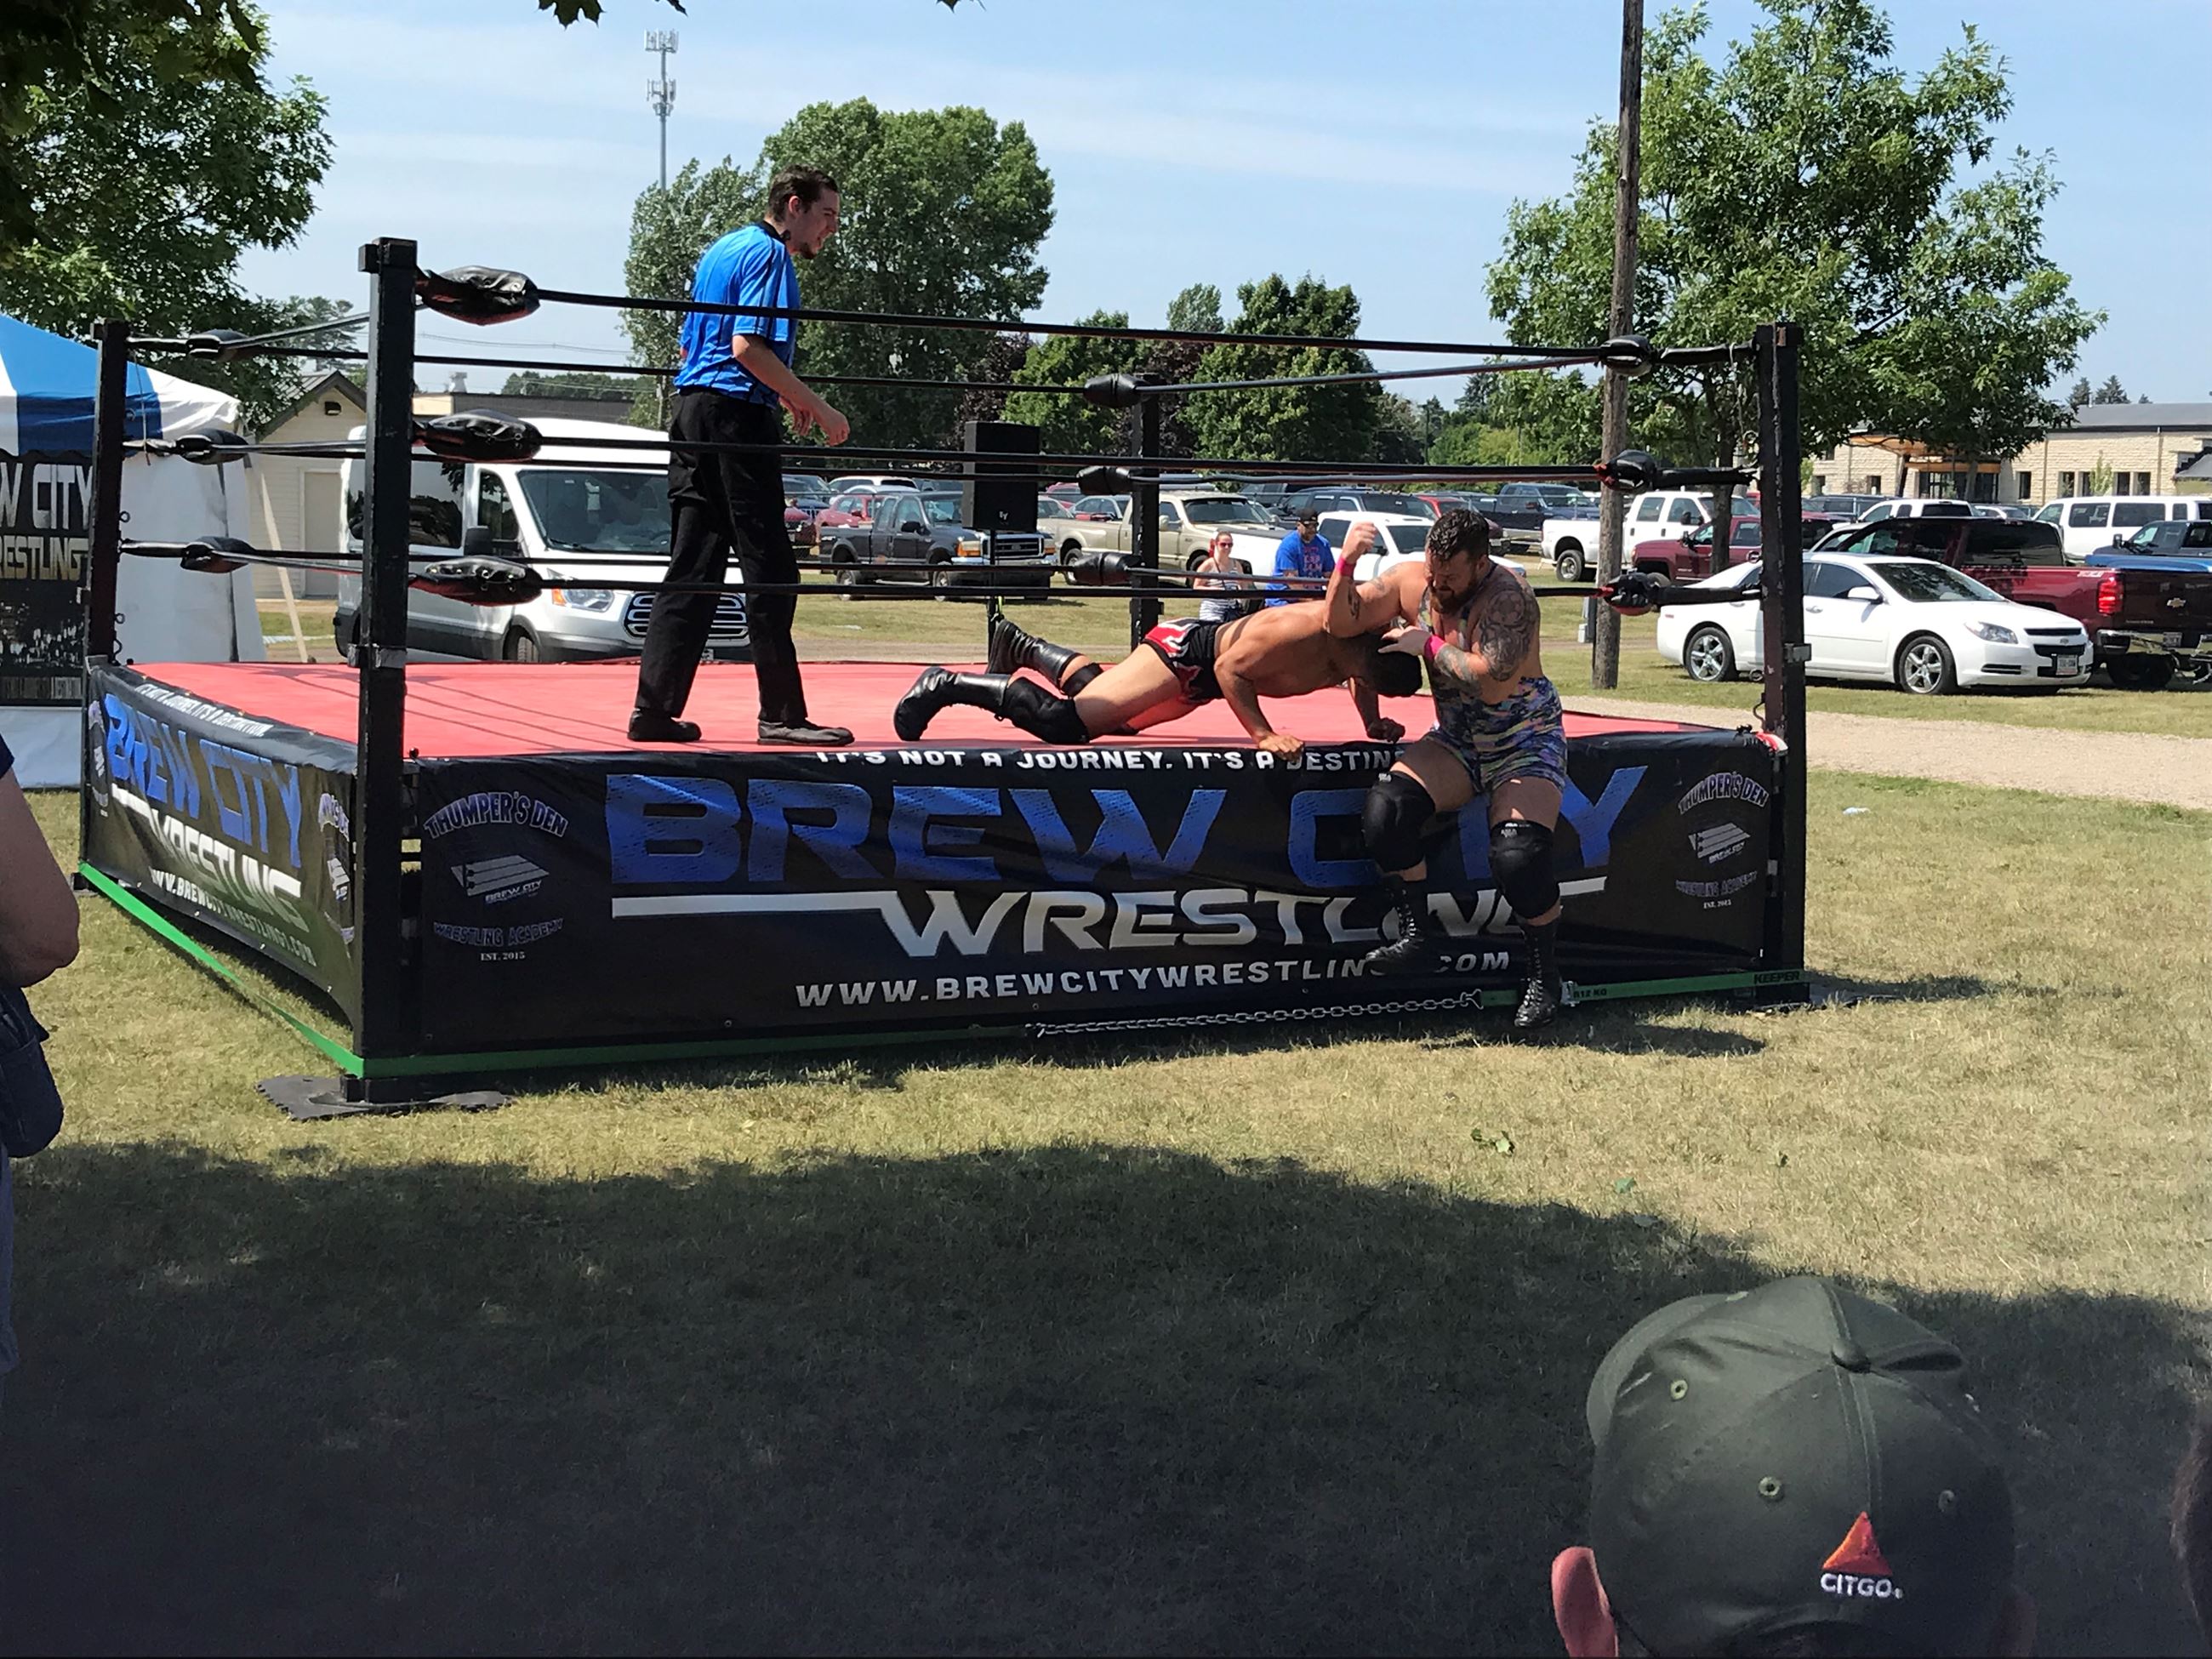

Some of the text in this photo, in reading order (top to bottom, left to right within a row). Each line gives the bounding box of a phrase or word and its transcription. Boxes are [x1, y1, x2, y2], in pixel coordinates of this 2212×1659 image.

[32, 463, 93, 530] CITY
[0, 535, 89, 580] ESTLING
[104, 693, 302, 869] BREW CITY
[817, 750, 1405, 771] IT'S NOT A JOURNEY. IT'S A DESTIN
[424, 790, 569, 840] THUMPER'S DEN
[1678, 770, 1770, 815] THUMPER'S DEN
[605, 772, 1228, 884] BREW
[433, 918, 564, 948] WRESTLING ACADEMY
[881, 876, 1606, 957] WRESTLN
[480, 952, 502, 961] EST.
[1820, 1573, 1893, 1599] CITGO
